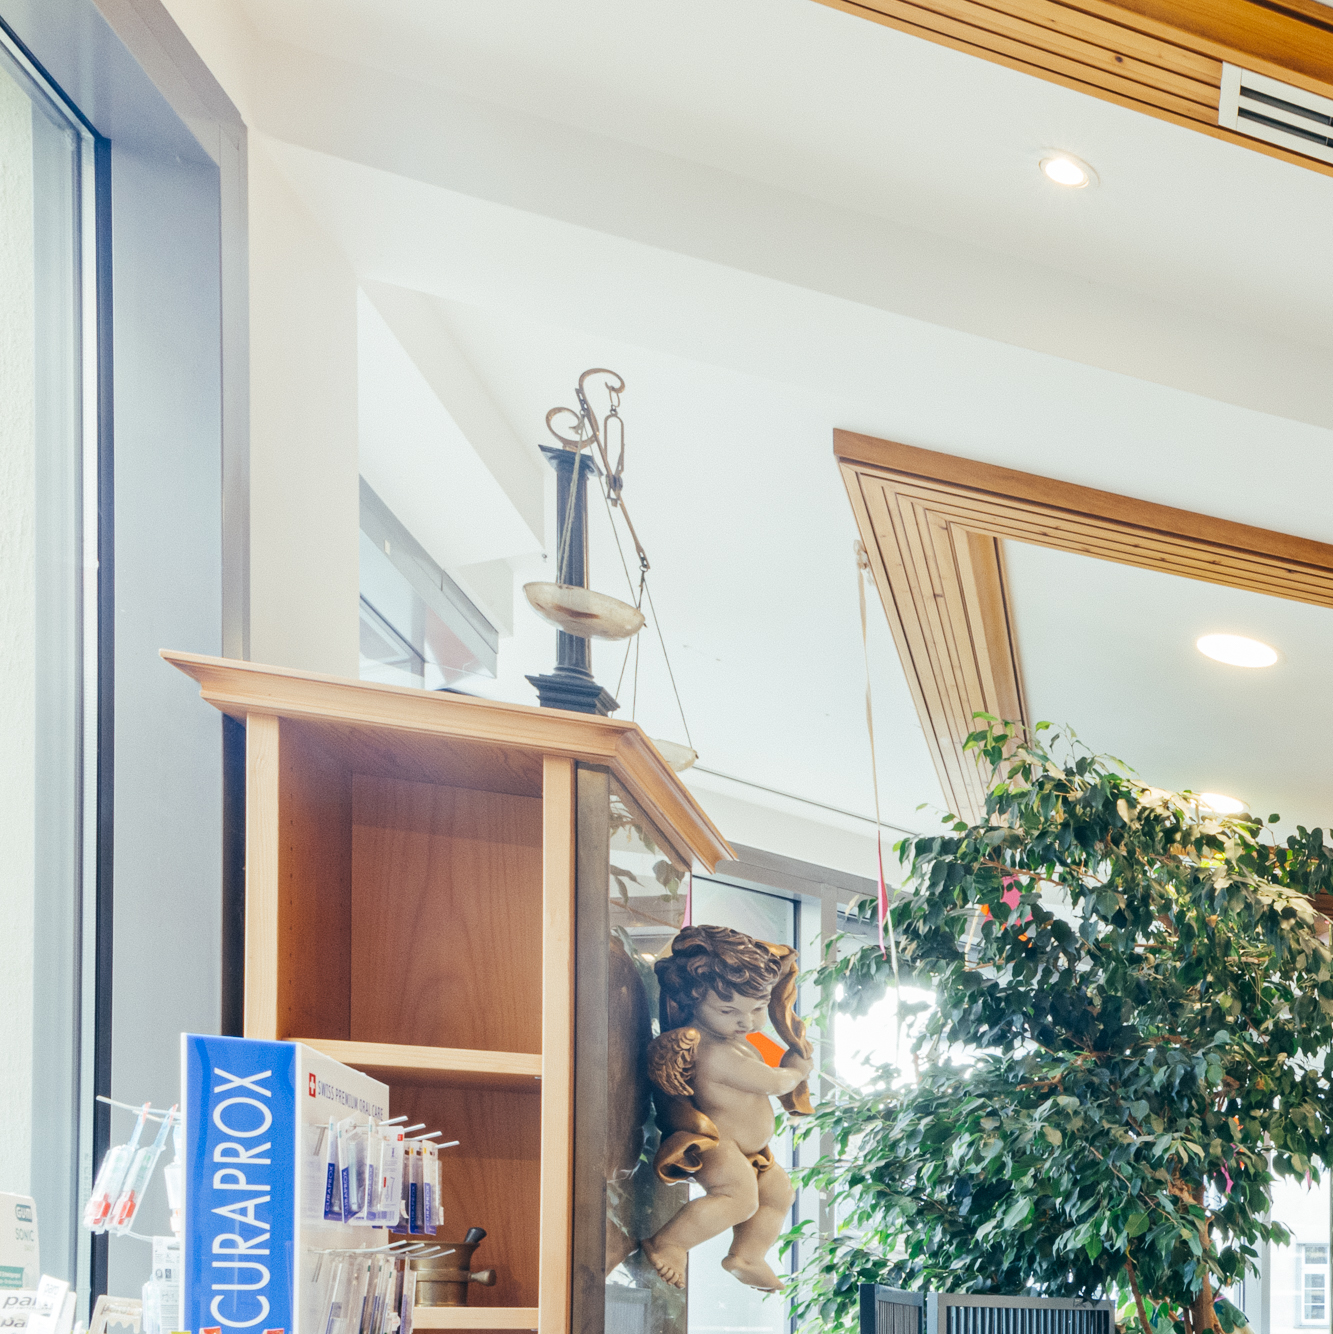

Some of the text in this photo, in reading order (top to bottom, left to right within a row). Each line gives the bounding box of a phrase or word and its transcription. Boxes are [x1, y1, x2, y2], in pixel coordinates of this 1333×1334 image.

[317, 1080, 384, 1122] SWISS PREMIUM ORAL CARE
[15, 1204, 32, 1222] GUM
[210, 1066, 273, 1330] CURAPROX
[325, 1166, 335, 1214] CURAPROX
[342, 1169, 350, 1219] CURAPROX
